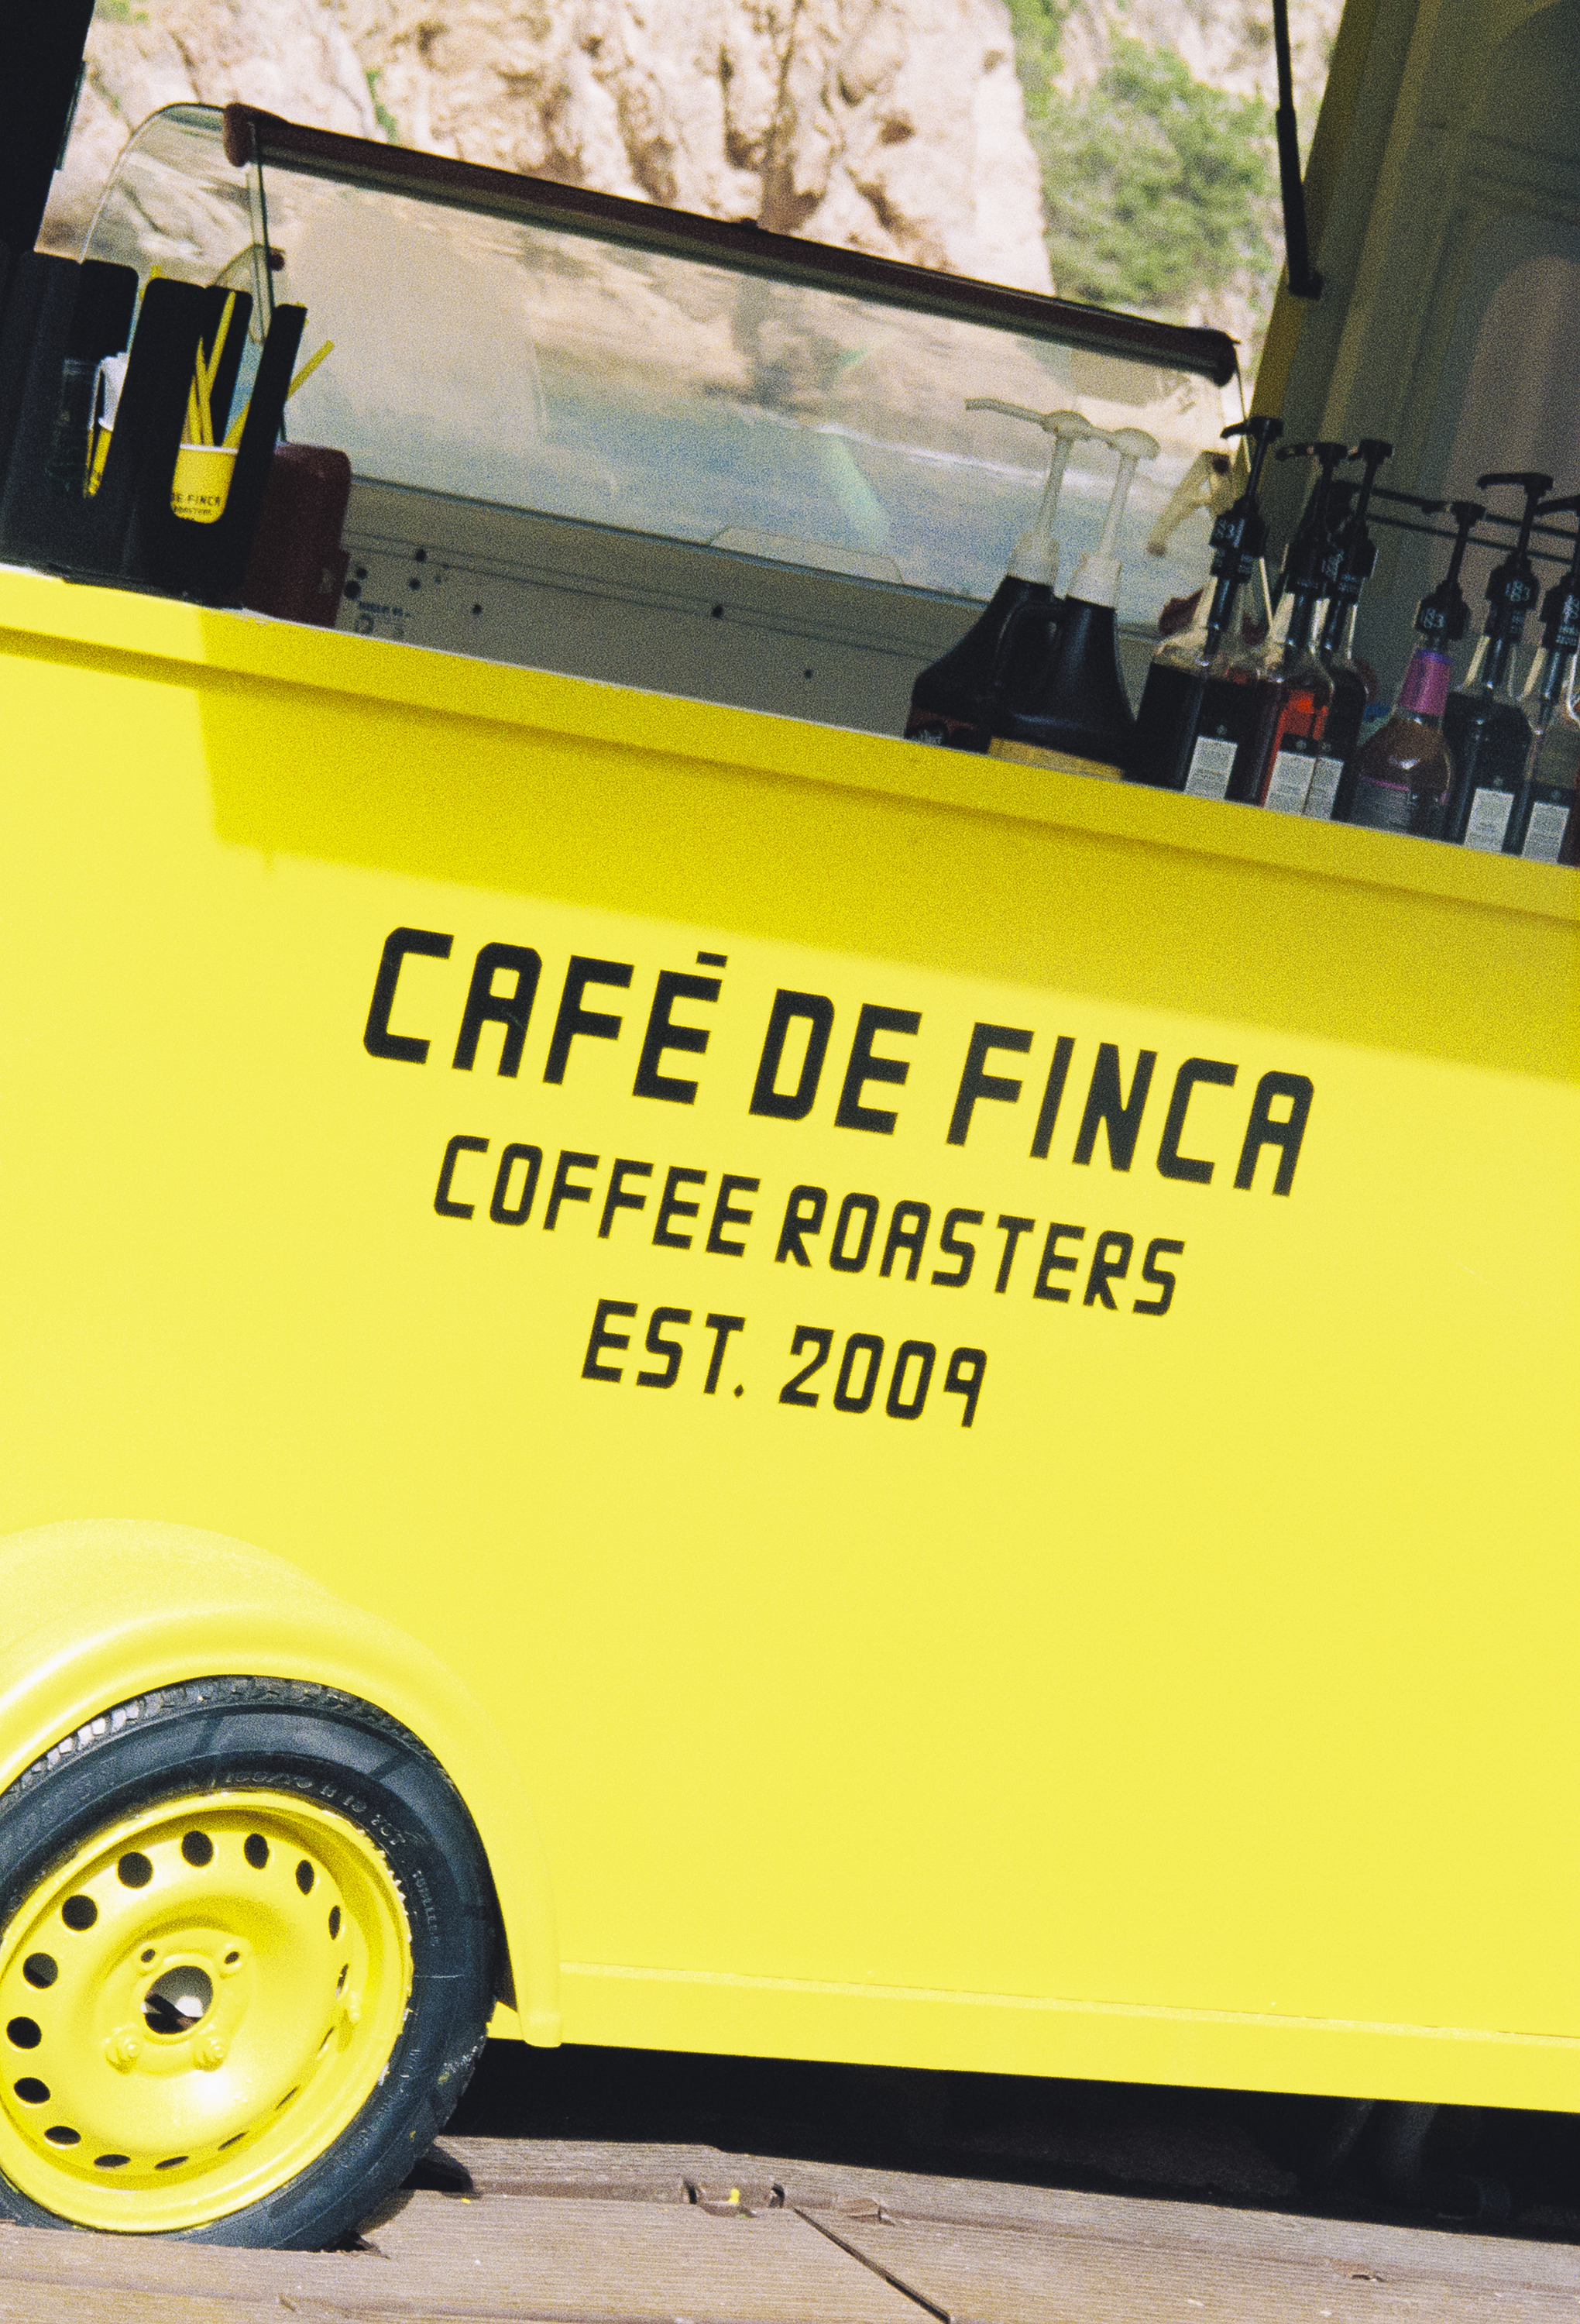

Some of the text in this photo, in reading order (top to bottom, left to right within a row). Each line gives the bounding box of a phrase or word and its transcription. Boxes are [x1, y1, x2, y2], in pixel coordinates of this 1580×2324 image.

[187, 493, 220, 507] FINCA
[364, 928, 1314, 1196] CAFÉ DE FINCA
[435, 1136, 1183, 1315] COFFEE ROASTERS
[582, 1300, 987, 1427] EST. 2009
